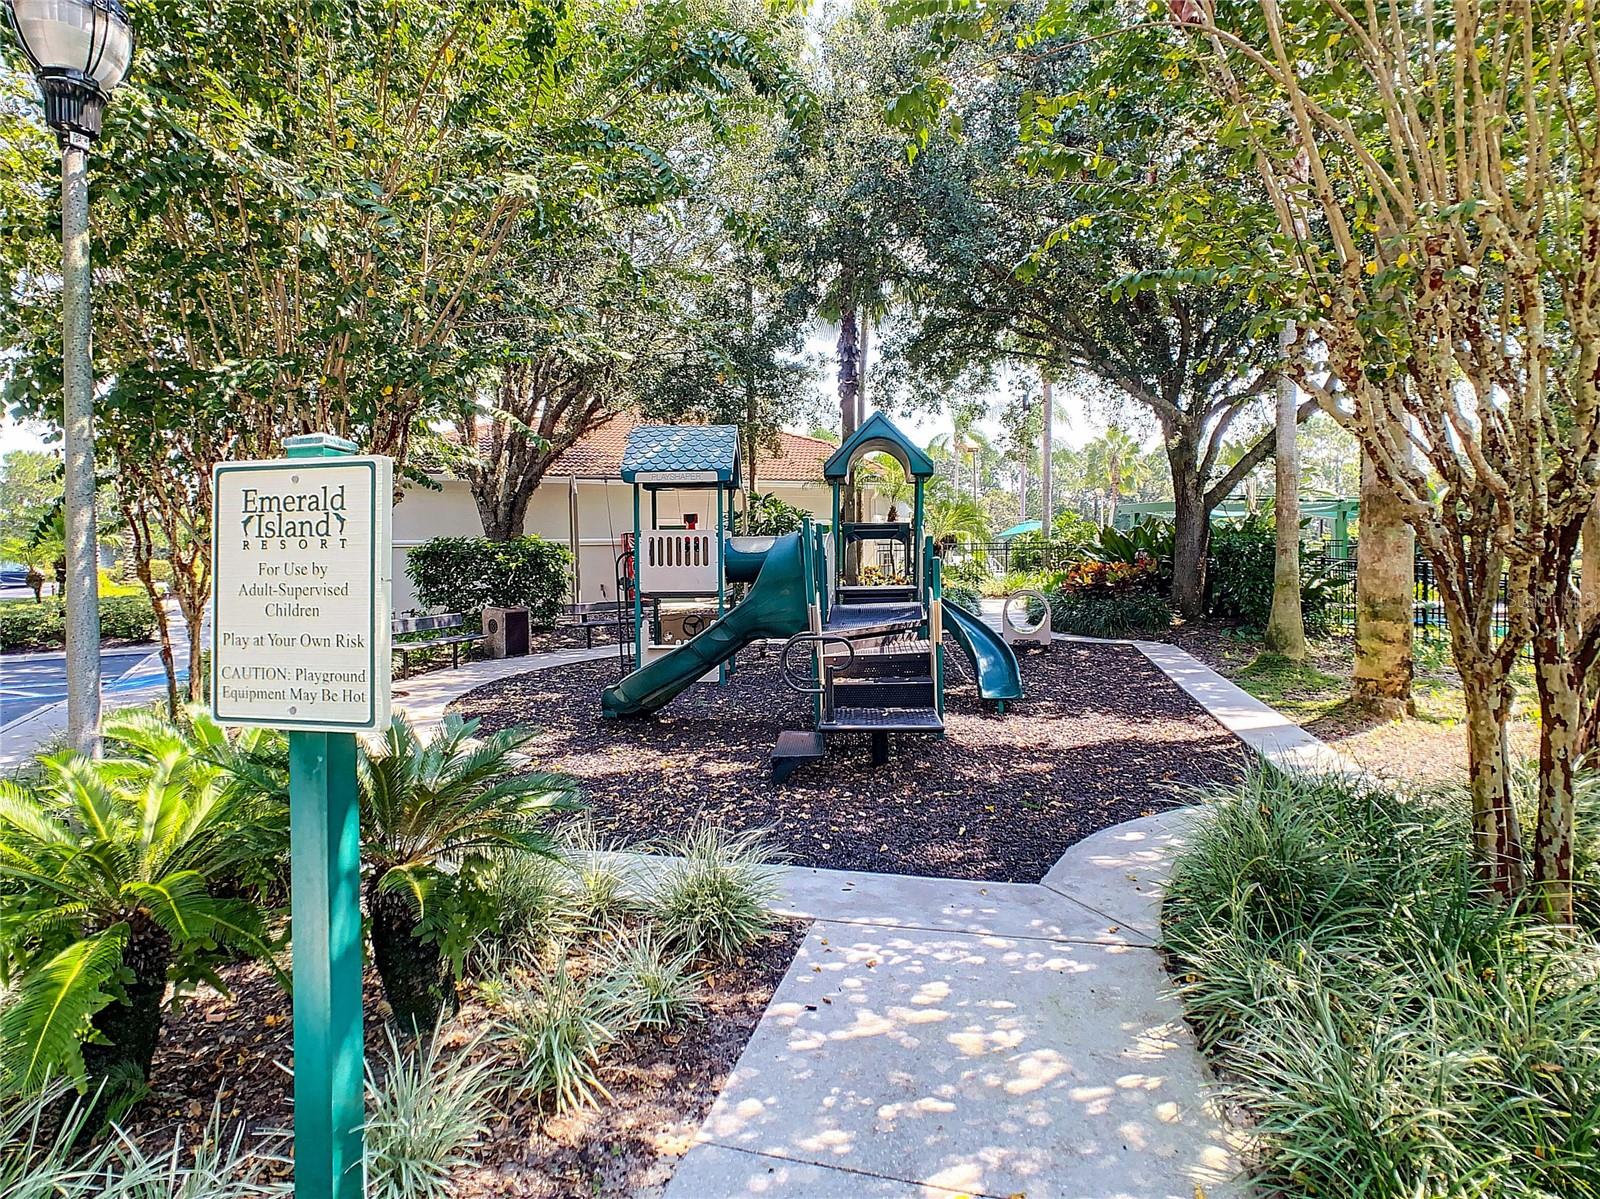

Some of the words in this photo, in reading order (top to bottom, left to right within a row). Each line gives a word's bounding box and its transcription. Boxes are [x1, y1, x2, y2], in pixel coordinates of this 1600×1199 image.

[242, 486, 346, 513] Emerald
[255, 512, 331, 538] Island
[243, 539, 347, 550] RESORT
[258, 563, 280, 576] For
[284, 563, 308, 576] Use
[311, 562, 328, 579] by
[239, 583, 348, 600] Adult-Supervised
[265, 603, 320, 617] Children
[223, 633, 250, 650] Play
[253, 635, 264, 646] at
[267, 633, 296, 647] Your
[300, 634, 331, 647] Own
[336, 634, 365, 648] Risk
[222, 667, 291, 680] CAUTION:
[296, 668, 366, 685] Playground
[222, 686, 286, 702] Equipment
[290, 688, 318, 704] May
[322, 689, 339, 701] Be
[342, 689, 366, 703] Hot
